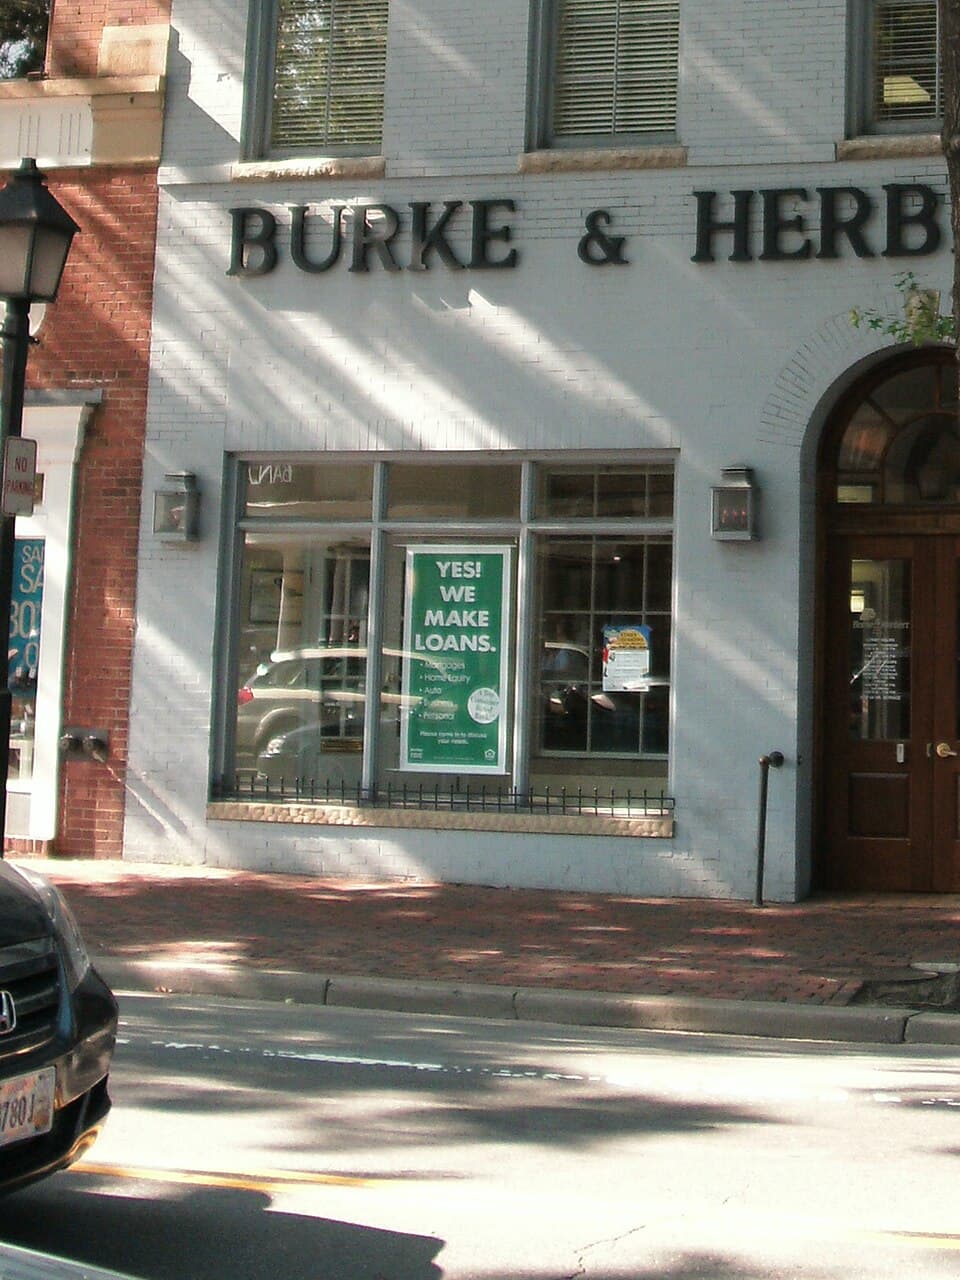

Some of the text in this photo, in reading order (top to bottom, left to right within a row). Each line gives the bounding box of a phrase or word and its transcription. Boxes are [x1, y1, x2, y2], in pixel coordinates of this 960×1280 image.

[225, 198, 518, 277] BURKE
[576, 209, 629, 267] &
[15, 456, 28, 473] NO
[6, 479, 35, 496] PARKING
[436, 561, 482, 578] YES!
[440, 585, 476, 603] WE
[424, 610, 489, 627] MAKE
[415, 634, 497, 652] LOANS.
[424, 687, 442, 695] Auto
